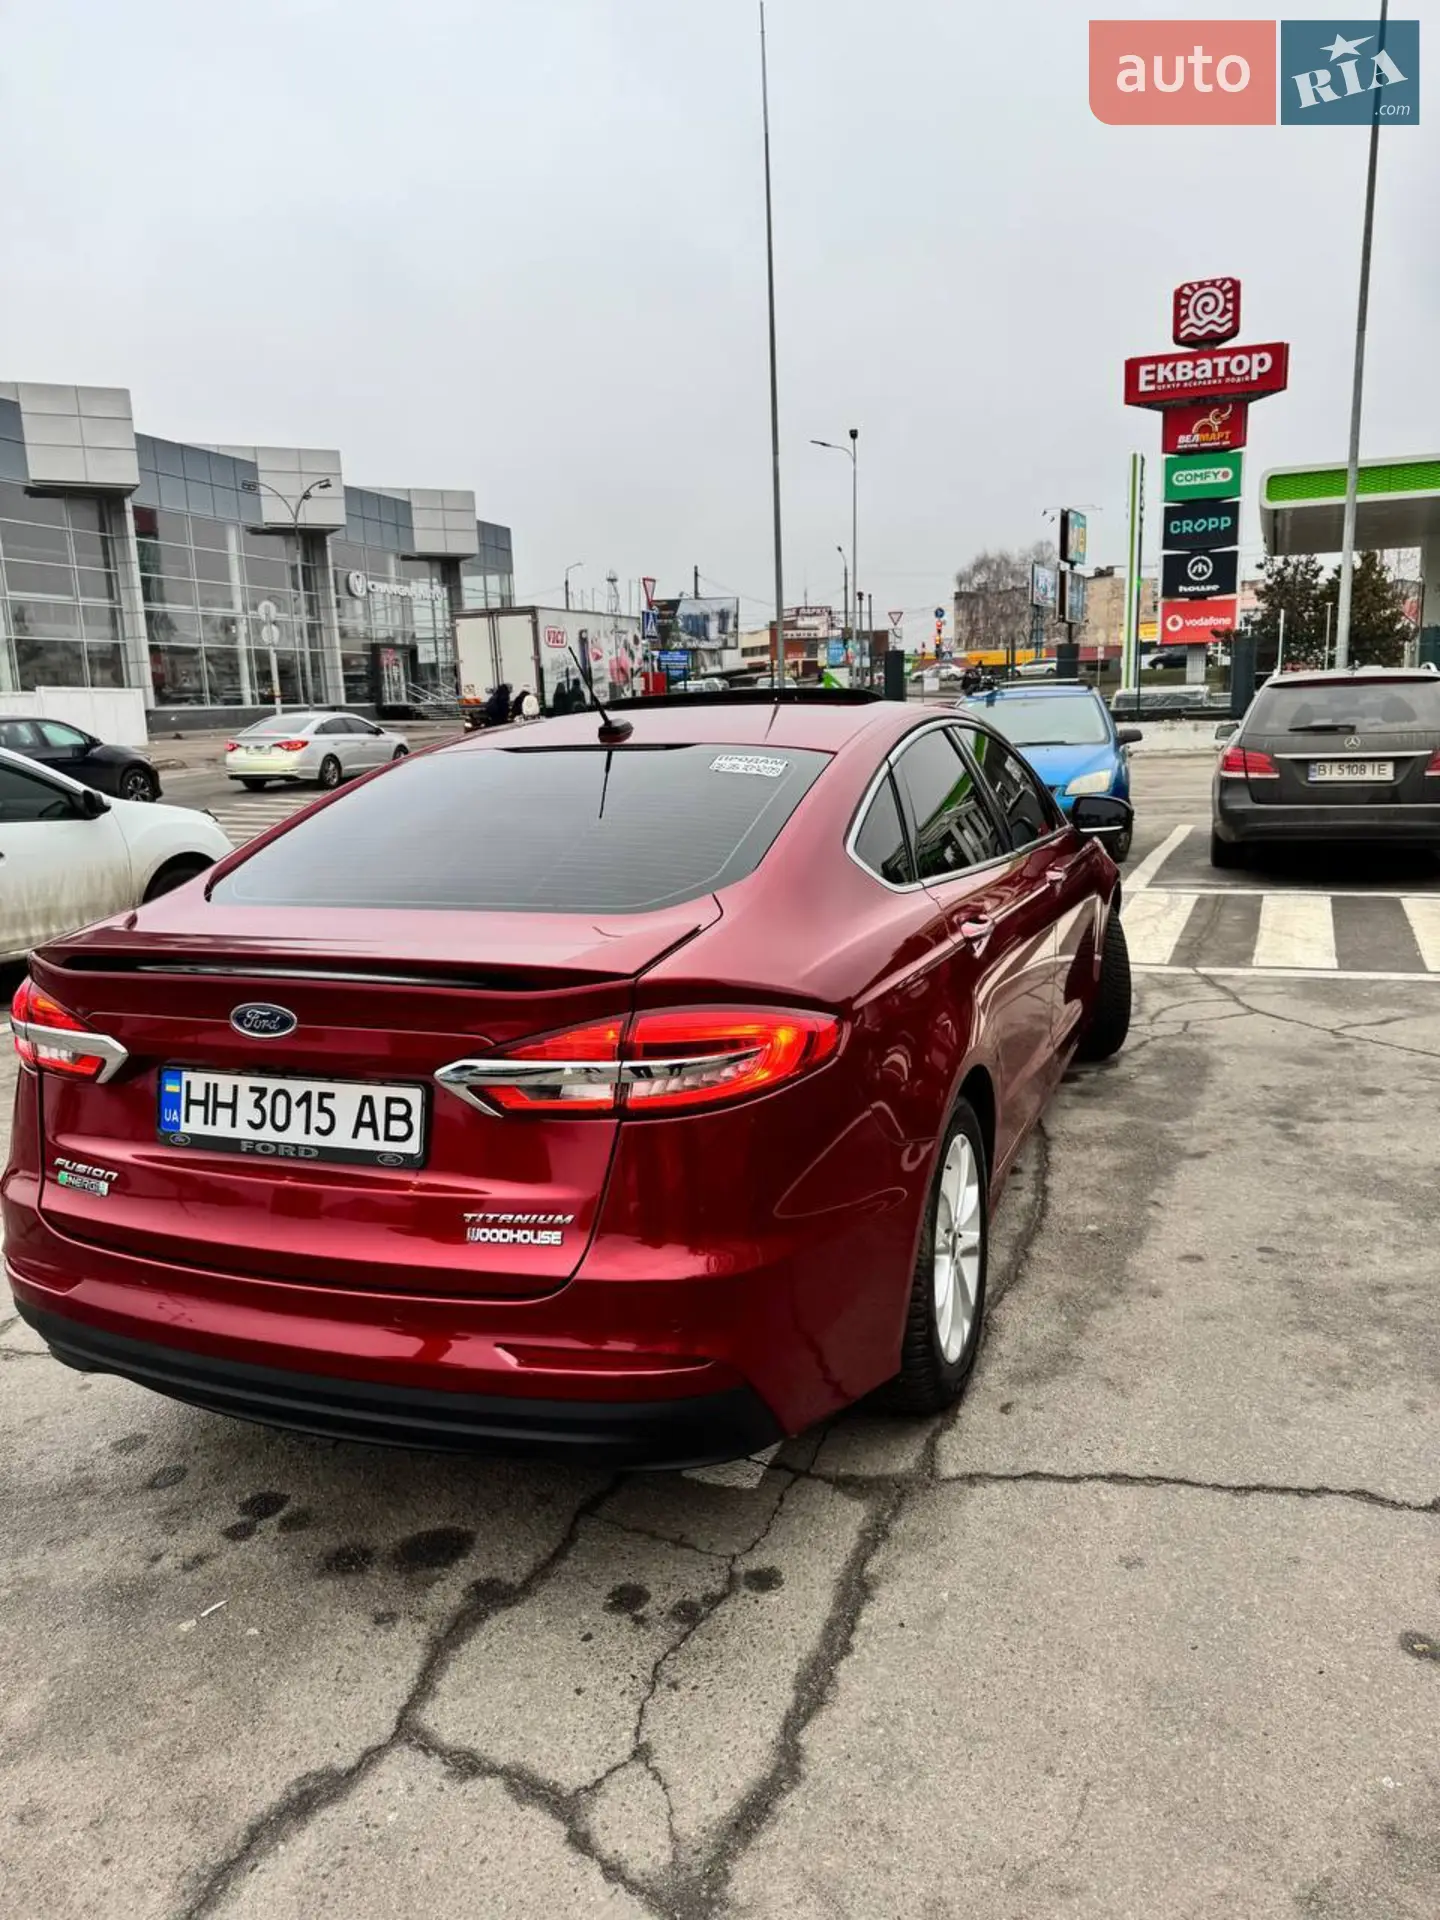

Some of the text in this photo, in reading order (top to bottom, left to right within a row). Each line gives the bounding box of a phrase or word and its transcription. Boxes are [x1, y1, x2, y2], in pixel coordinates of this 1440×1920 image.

[1175, 471, 1220, 483] COMFY
[1169, 516, 1232, 535] CROPP
[1184, 615, 1233, 626] vodafone
[1337, 763, 1367, 776] 5108
[243, 1008, 281, 1031] Ford
[164, 1108, 179, 1123] UA
[184, 1080, 415, 1143] HH 3015 AB
[240, 1140, 319, 1158] FORD
[54, 1157, 119, 1181] FUSION
[463, 1212, 575, 1225] TITANIUM
[466, 1227, 562, 1245] WOODHOUSE
